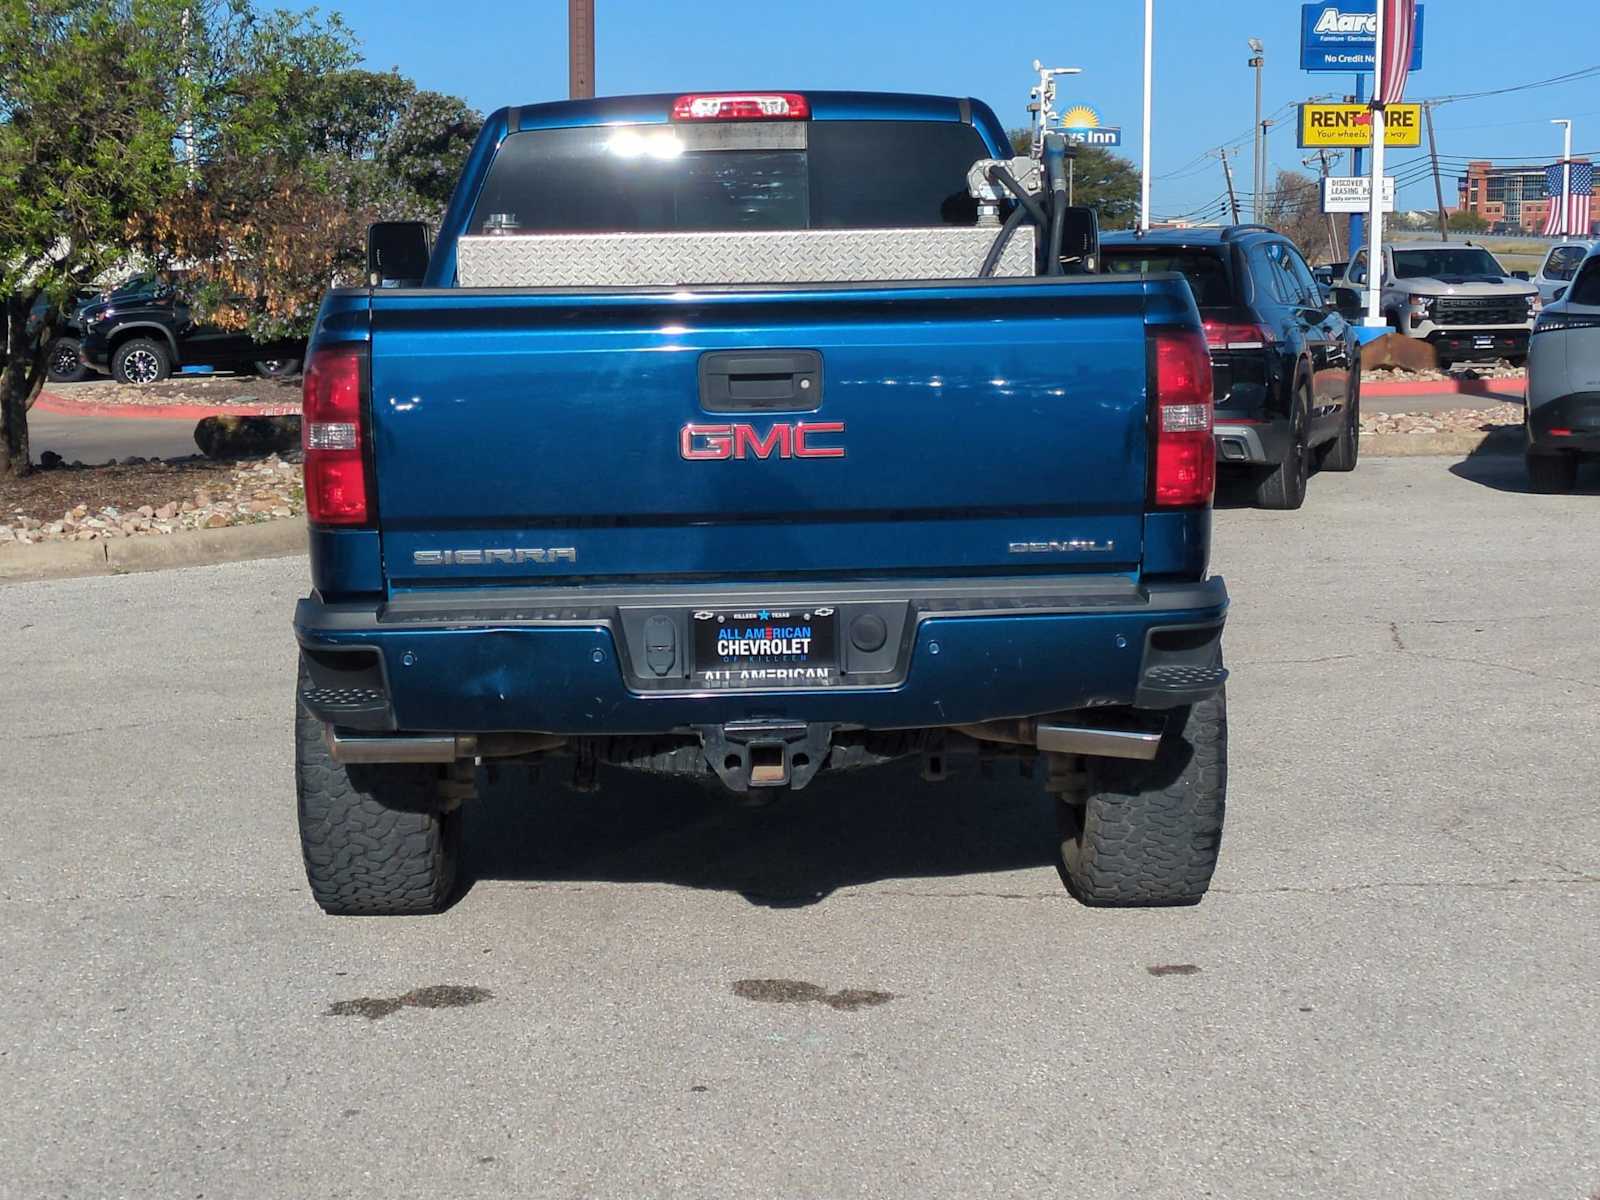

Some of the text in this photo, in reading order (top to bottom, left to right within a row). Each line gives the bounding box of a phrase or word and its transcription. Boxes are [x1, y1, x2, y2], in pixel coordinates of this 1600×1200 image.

[1325, 54, 1337, 63] No
[1338, 54, 1364, 63] Credit
[1311, 111, 1414, 127] RENT IRE
[1088, 130, 1116, 144] Inn
[1317, 130, 1334, 138] Your
[1337, 130, 1368, 138] wheels,
[1391, 131, 1407, 140] way
[1331, 187, 1359, 195] LEASING
[680, 421, 846, 461] GMC
[413, 547, 577, 565] SIERRA
[718, 627, 811, 640] ALL AMERICAN
[717, 638, 812, 656] CHEVROLET
